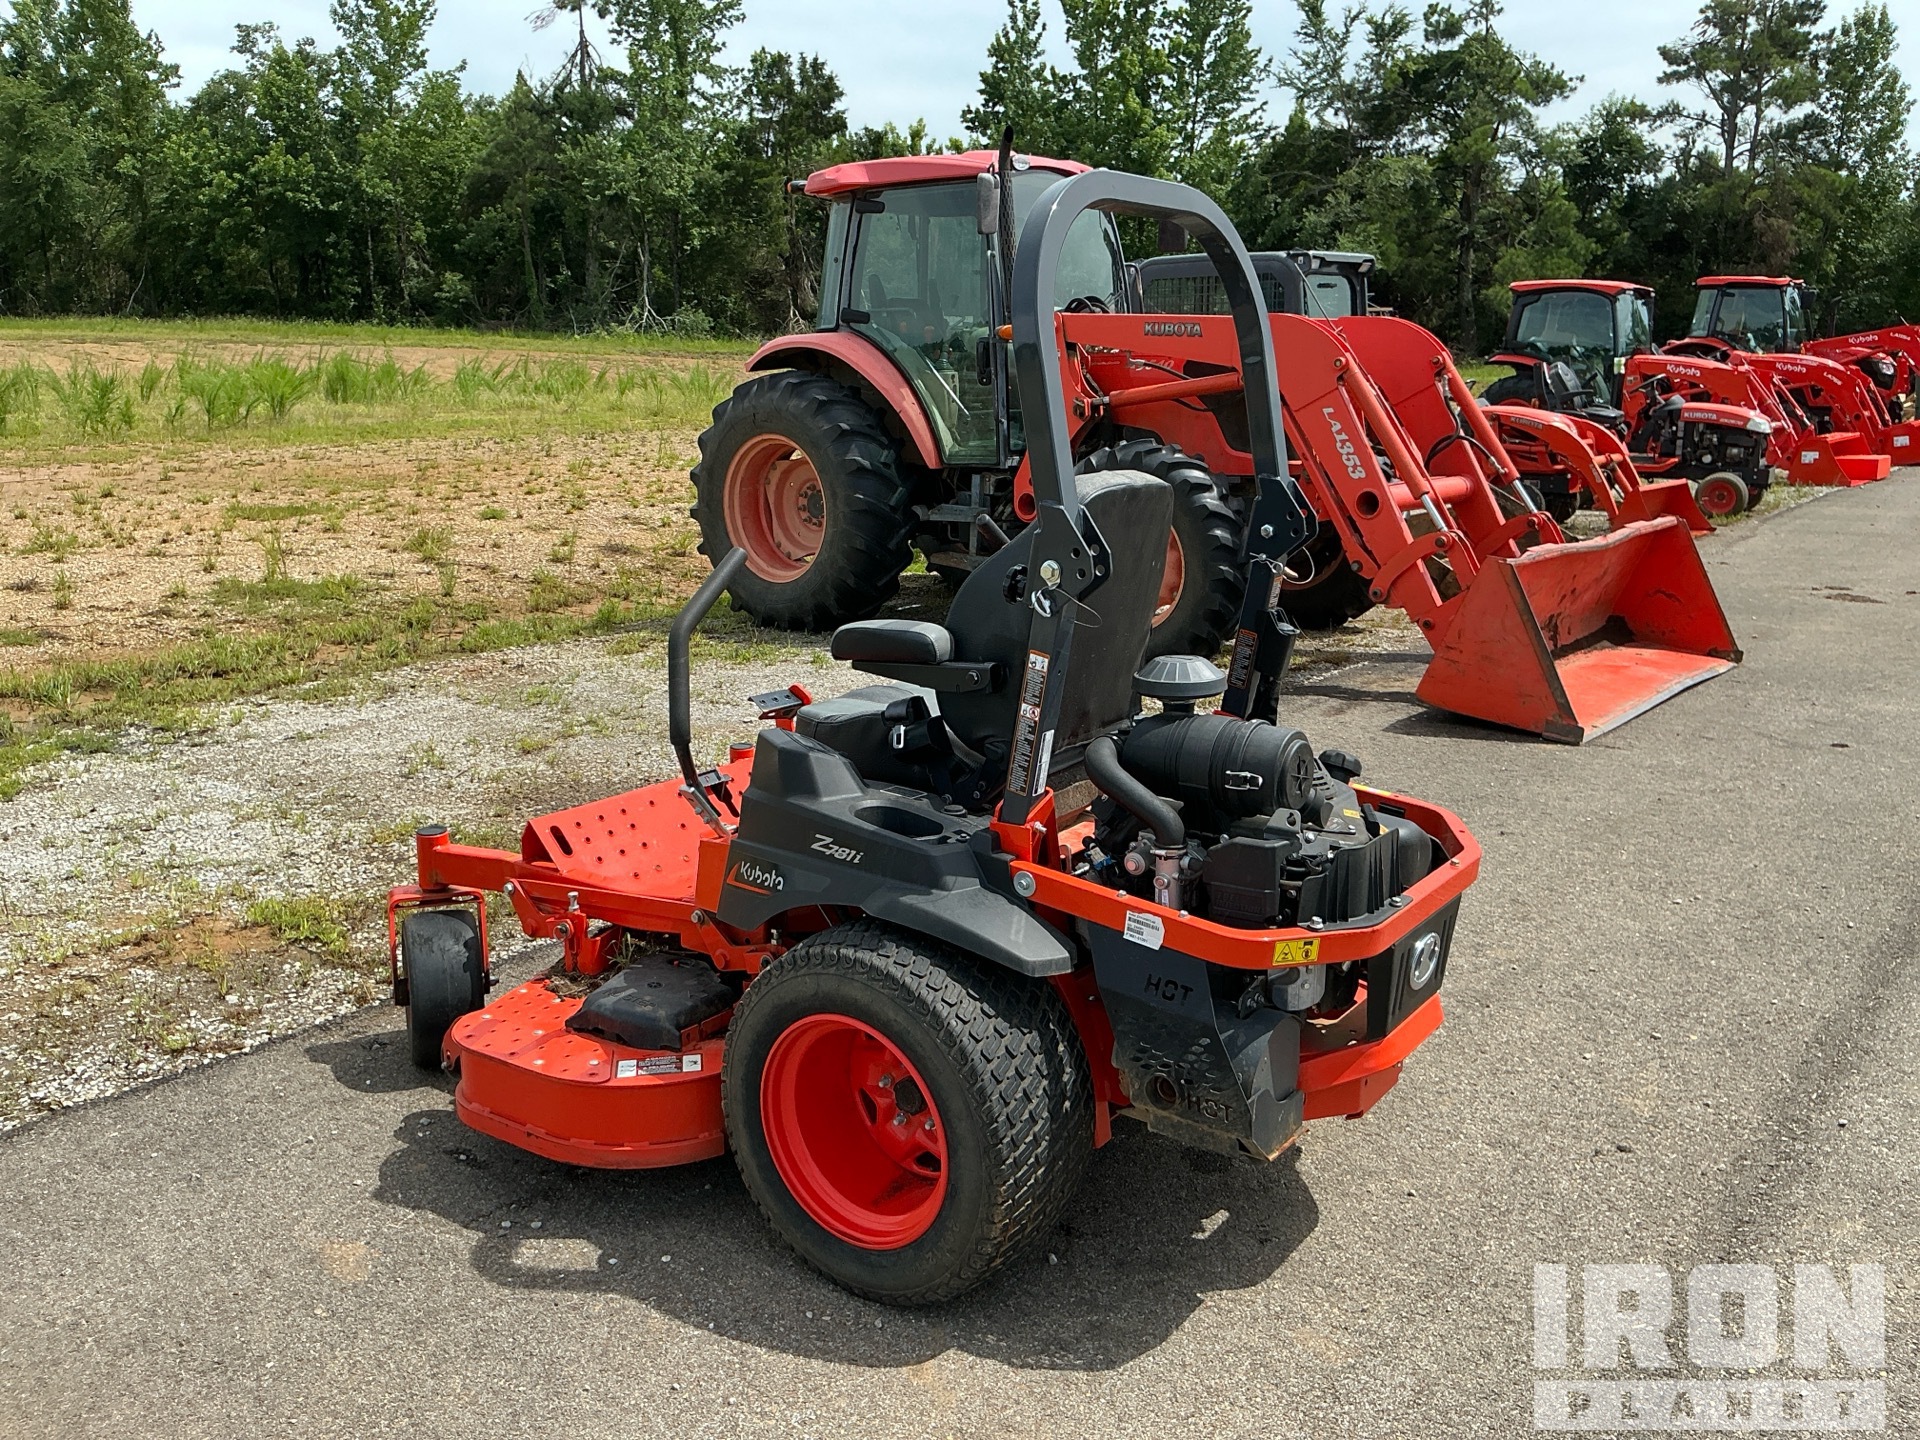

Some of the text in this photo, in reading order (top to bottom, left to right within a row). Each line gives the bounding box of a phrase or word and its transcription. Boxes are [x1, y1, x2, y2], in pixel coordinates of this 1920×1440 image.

[1144, 322, 1203, 337] KUBOTA
[1848, 334, 1879, 345] Kubota
[1667, 363, 1701, 377] Kubota
[1775, 362, 1807, 374] Kubota
[1684, 411, 1717, 420] KUBOTA
[1322, 407, 1367, 480] LA1353
[810, 833, 864, 864] Z781i
[740, 861, 784, 890] Kubota
[1144, 973, 1194, 1006] HOT
[1186, 1093, 1233, 1124] HOT
